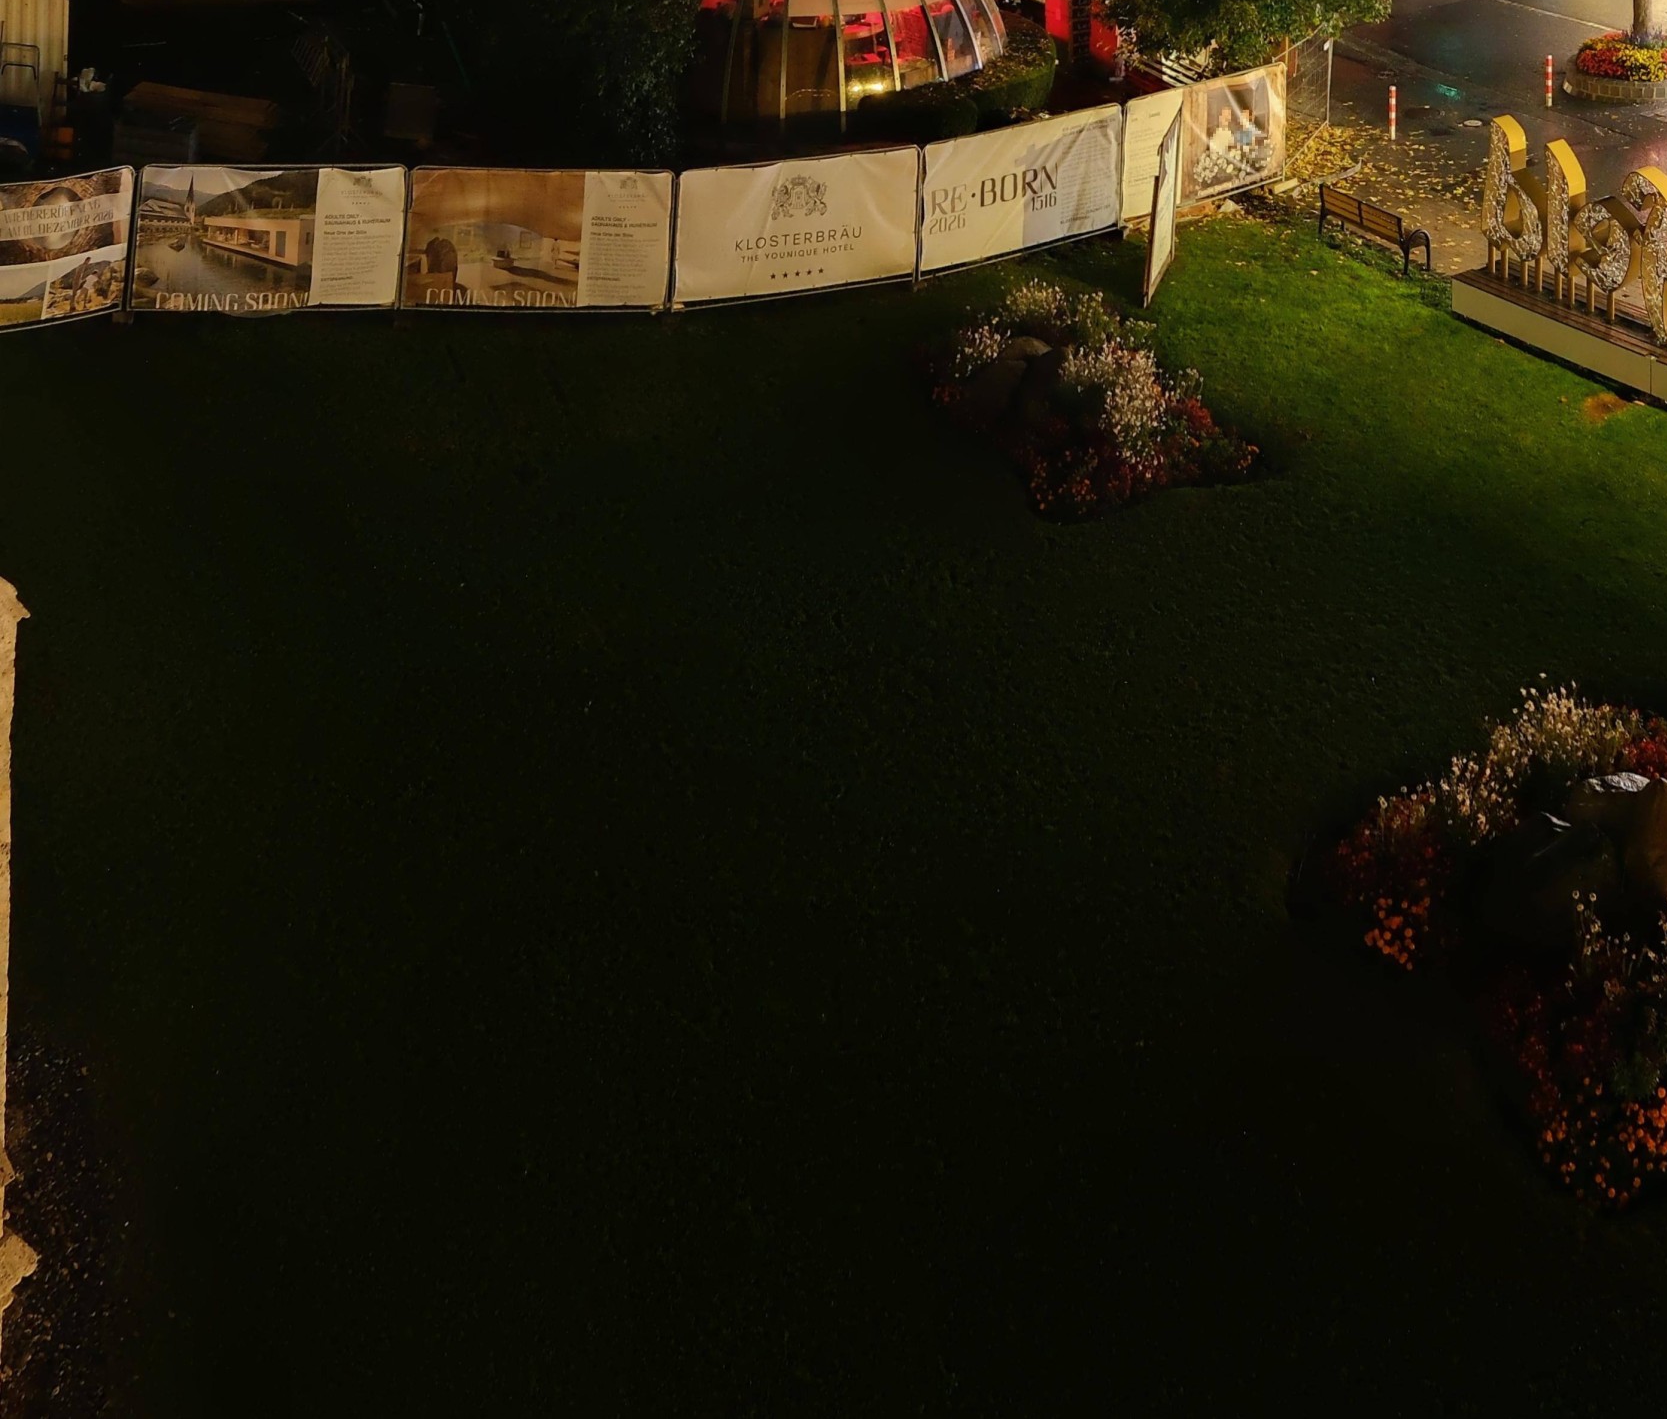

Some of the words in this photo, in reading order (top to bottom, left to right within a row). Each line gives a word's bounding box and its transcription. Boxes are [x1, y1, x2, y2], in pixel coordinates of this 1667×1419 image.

[929, 213, 967, 234] 2026
[1031, 192, 1057, 212] 1516
[38, 215, 90, 234] DEZEMBER
[734, 224, 863, 252] KLOSTERBRÄU
[741, 255, 759, 263] THE
[765, 247, 818, 261] YOUNIQUE
[823, 243, 855, 255] HOTEL
[155, 292, 239, 311] COMING
[244, 291, 310, 312] SOON!
[426, 288, 508, 306] COMING
